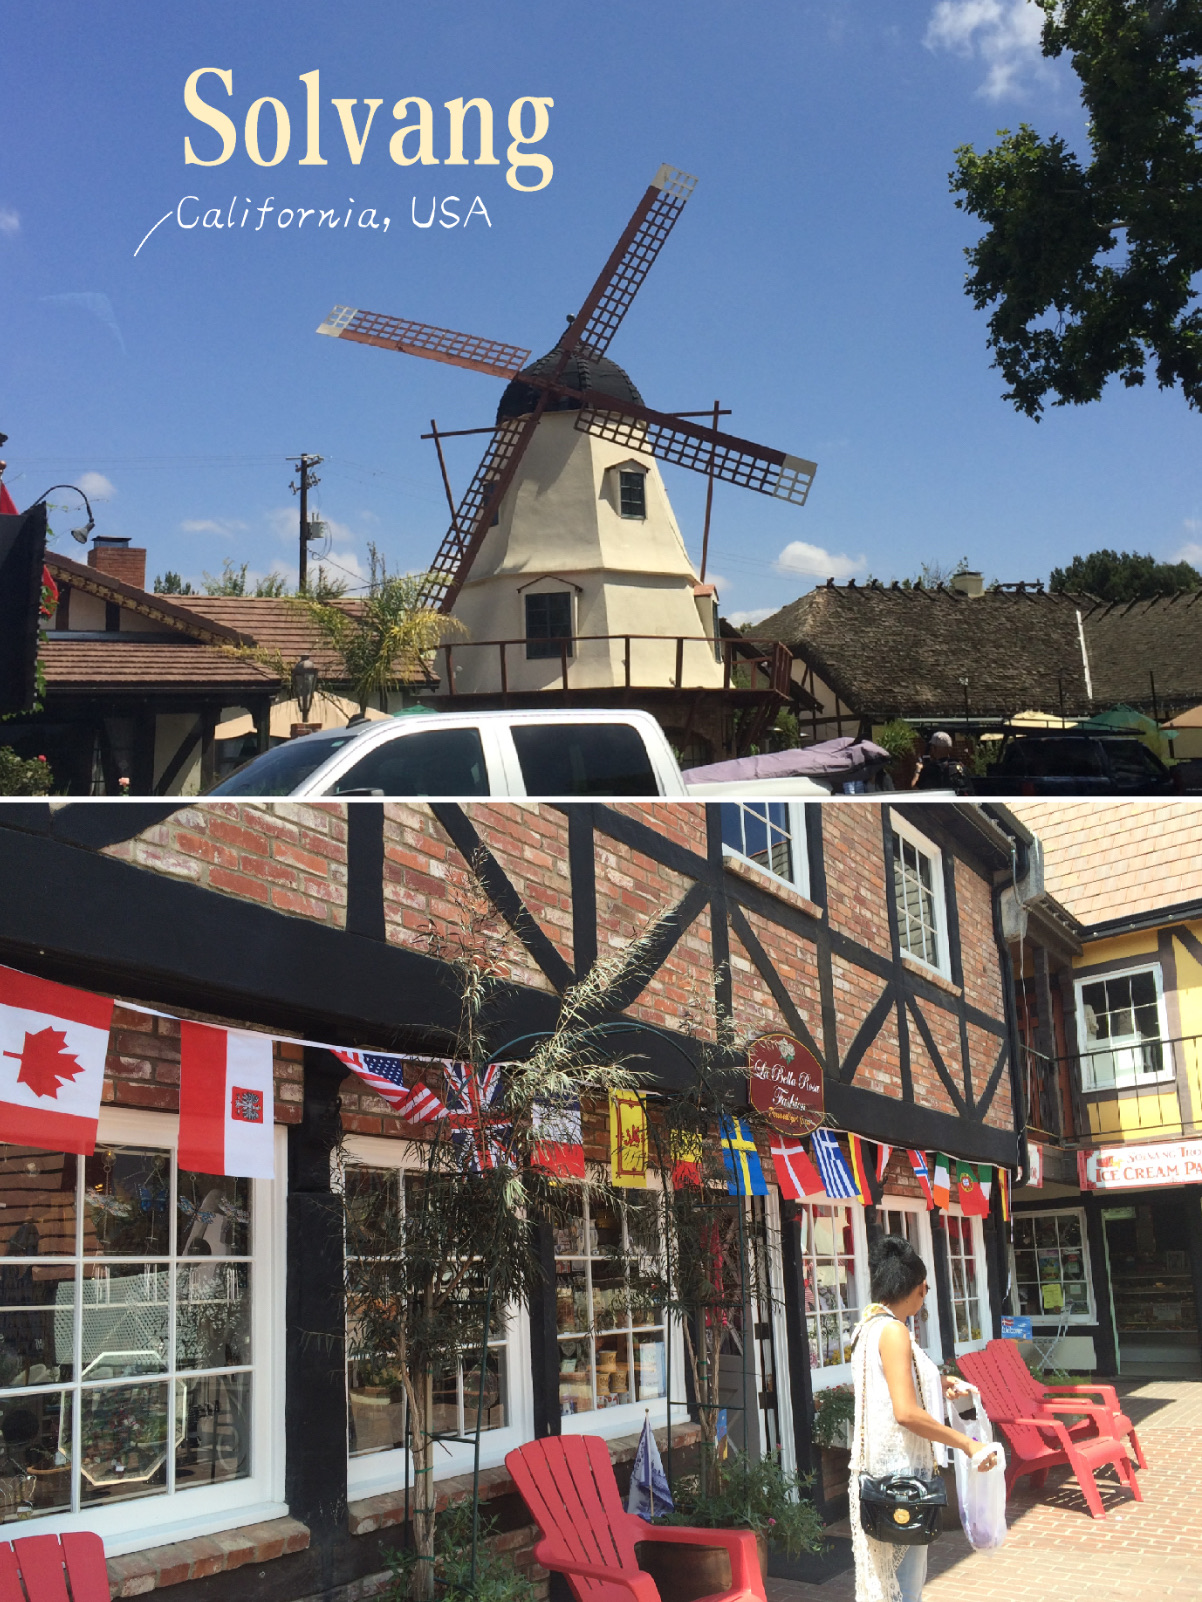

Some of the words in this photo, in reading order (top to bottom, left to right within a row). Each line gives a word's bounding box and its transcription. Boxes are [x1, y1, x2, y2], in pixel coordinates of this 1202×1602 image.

[754, 1059, 770, 1080] La
[771, 1064, 796, 1086] Bella
[798, 1072, 820, 1093] Rosa
[772, 1085, 806, 1111] Fashion
[1095, 1169, 1121, 1183] ICE
[1123, 1164, 1179, 1181] CREAM
